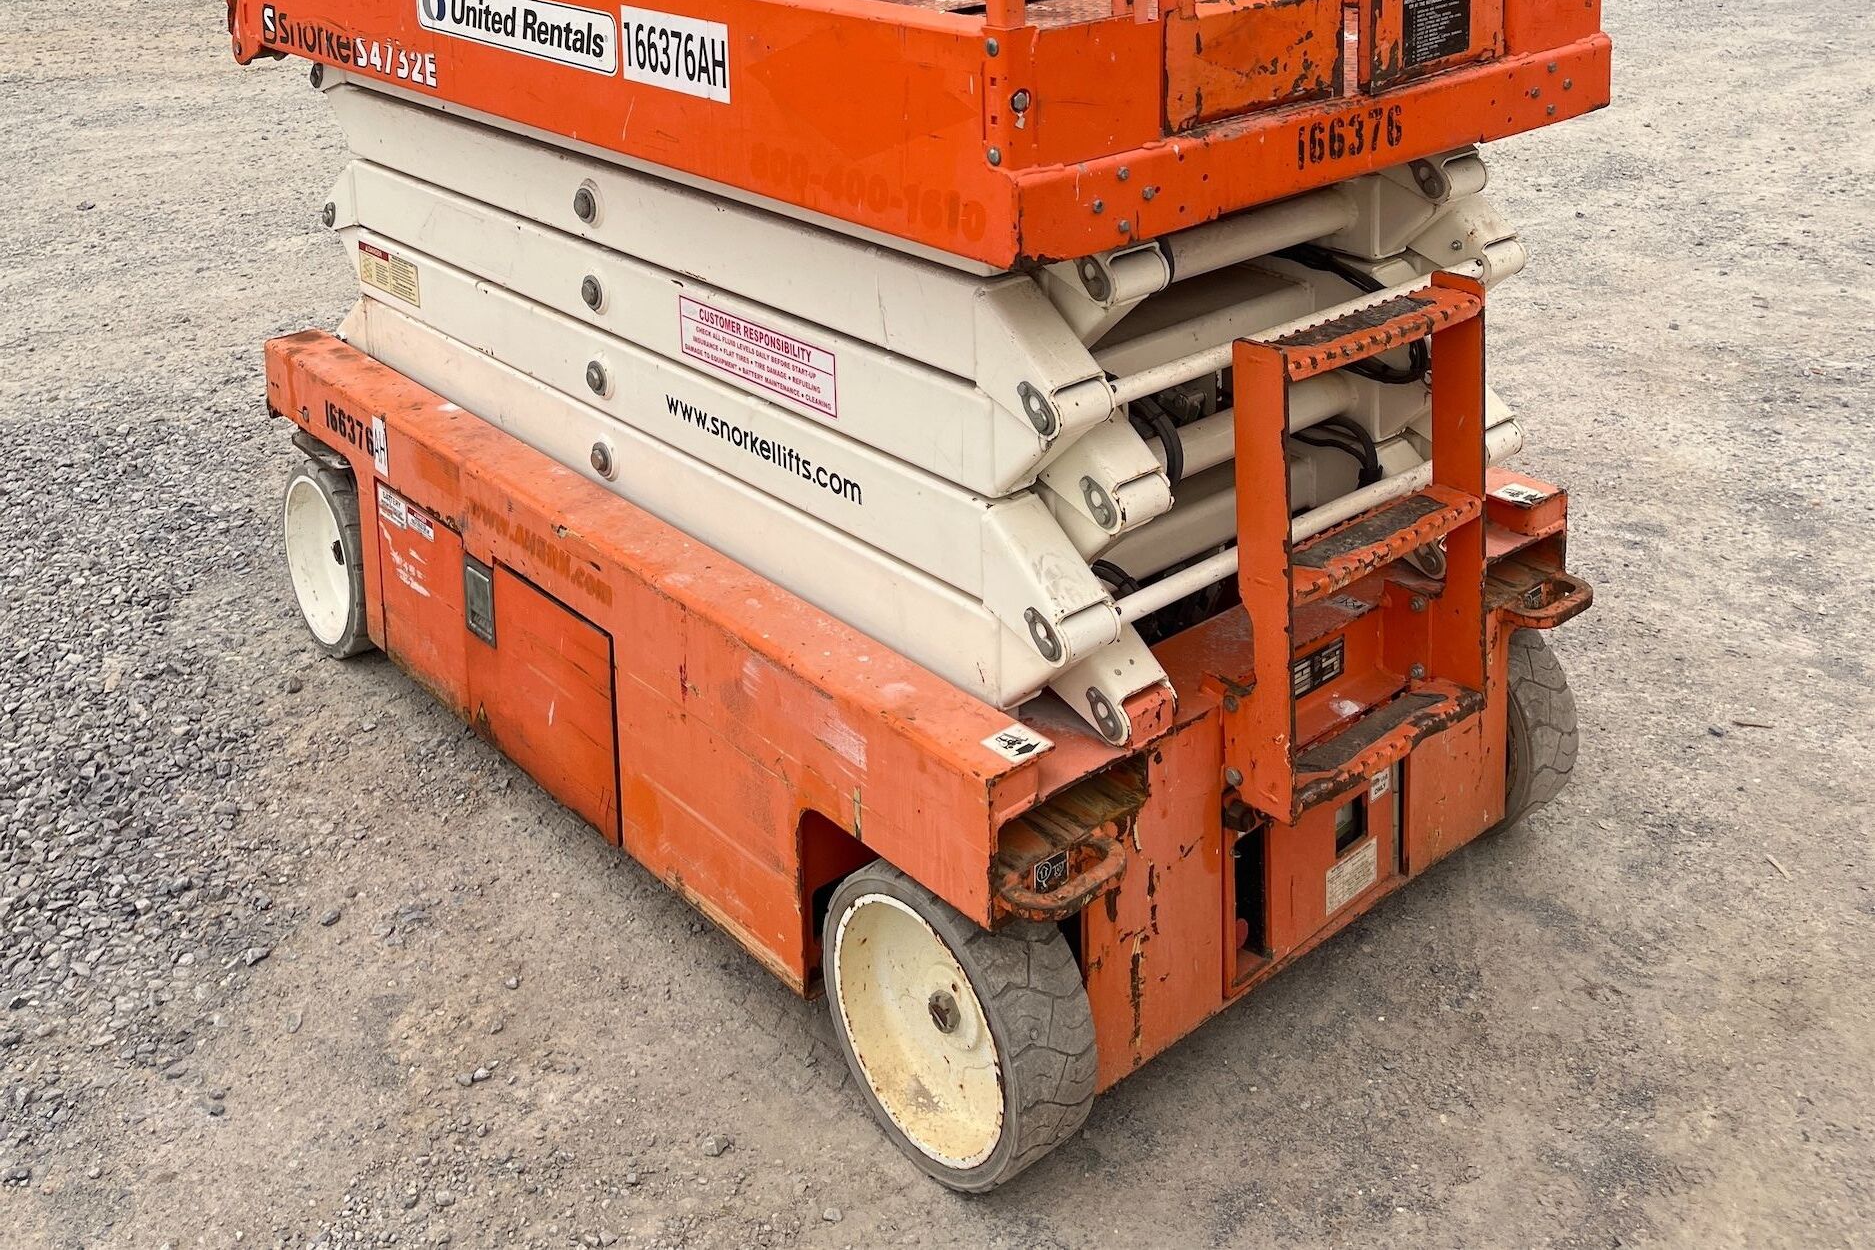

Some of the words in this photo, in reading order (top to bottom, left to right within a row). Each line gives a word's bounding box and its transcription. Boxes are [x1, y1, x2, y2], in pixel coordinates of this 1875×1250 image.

[522, 7, 605, 59] Rentals
[623, 21, 728, 89] 166376AH
[1298, 104, 1403, 171] 166376
[695, 325, 712, 338] CHECK
[712, 332, 722, 342] ALL
[722, 336, 736, 348] FLUID
[736, 342, 755, 356] LEVELS
[755, 349, 771, 362] DAILY
[771, 355, 791, 371] BEFORE
[792, 364, 817, 381] START-UP
[699, 308, 742, 335] CUSTOMER
[743, 324, 812, 363] RESPONSIBILITY
[684, 343, 704, 357] DAMAGE
[704, 350, 711, 359] TO
[711, 353, 738, 371] EQUIPMENT
[742, 366, 764, 383] BATTERY
[764, 376, 801, 399] MAINTENANCE
[804, 393, 832, 412] CLEANING
[693, 335, 719, 352] INSURANCE
[723, 347, 736, 359] FLAT
[735, 352, 750, 365] TIRES
[754, 360, 766, 370] TIRE
[766, 365, 788, 381] DAMAGE
[792, 375, 822, 395] REFUELING
[325, 400, 374, 457] 166376
[665, 394, 863, 505] www.snorkellifts.com
[1374, 782, 1386, 795] ONLY
